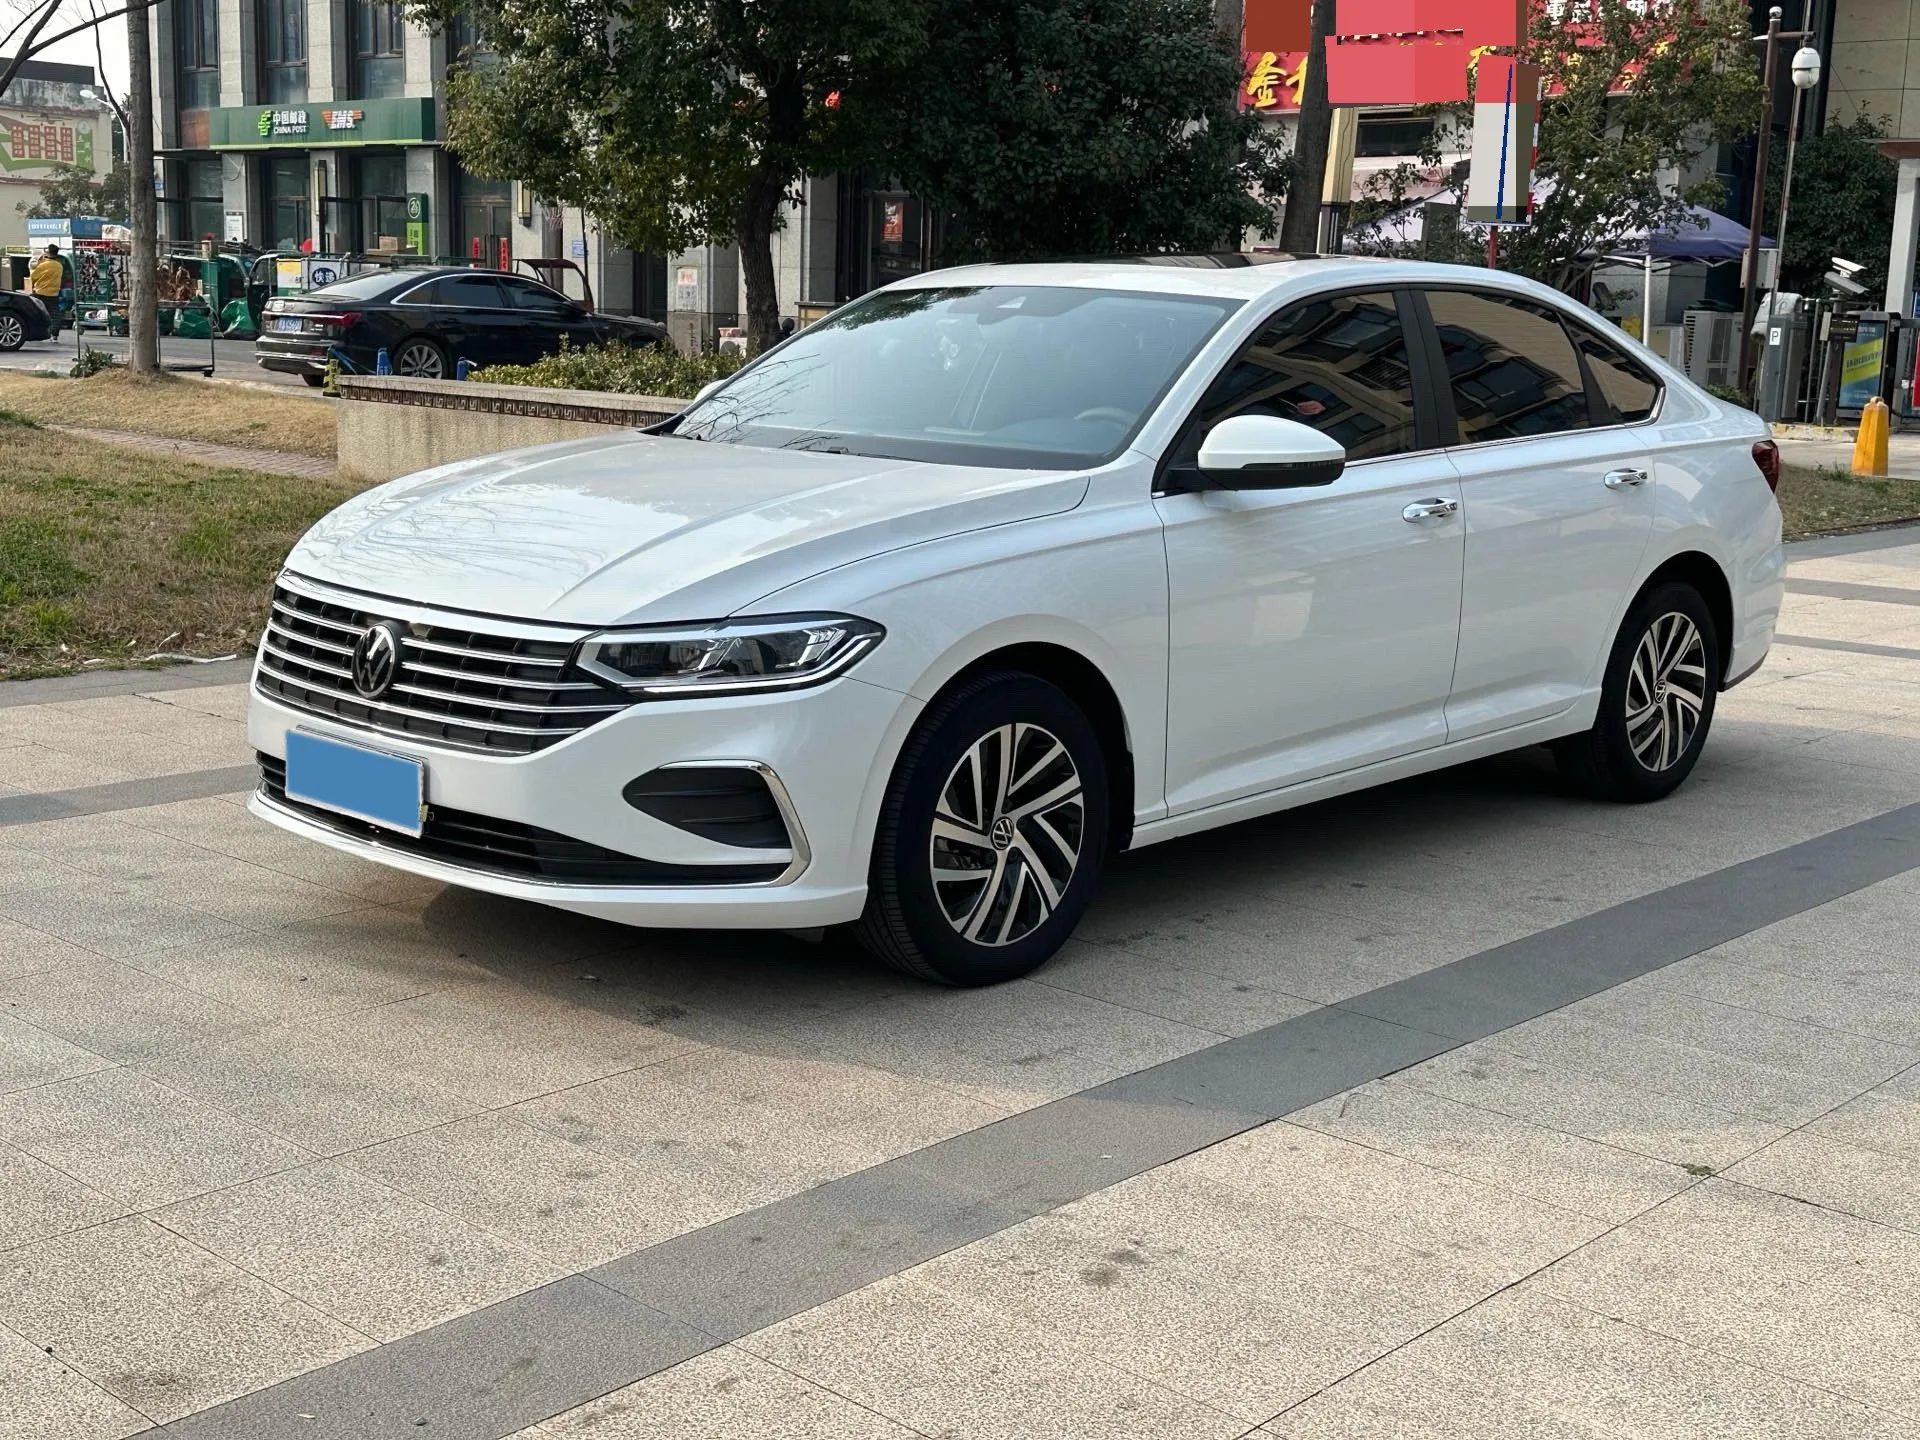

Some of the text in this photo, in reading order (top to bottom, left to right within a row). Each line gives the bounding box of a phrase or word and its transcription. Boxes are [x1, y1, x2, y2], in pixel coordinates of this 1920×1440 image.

[273, 110, 307, 125] 中国邮政
[329, 110, 354, 129] EMS
[274, 125, 307, 134] CHINA POST
